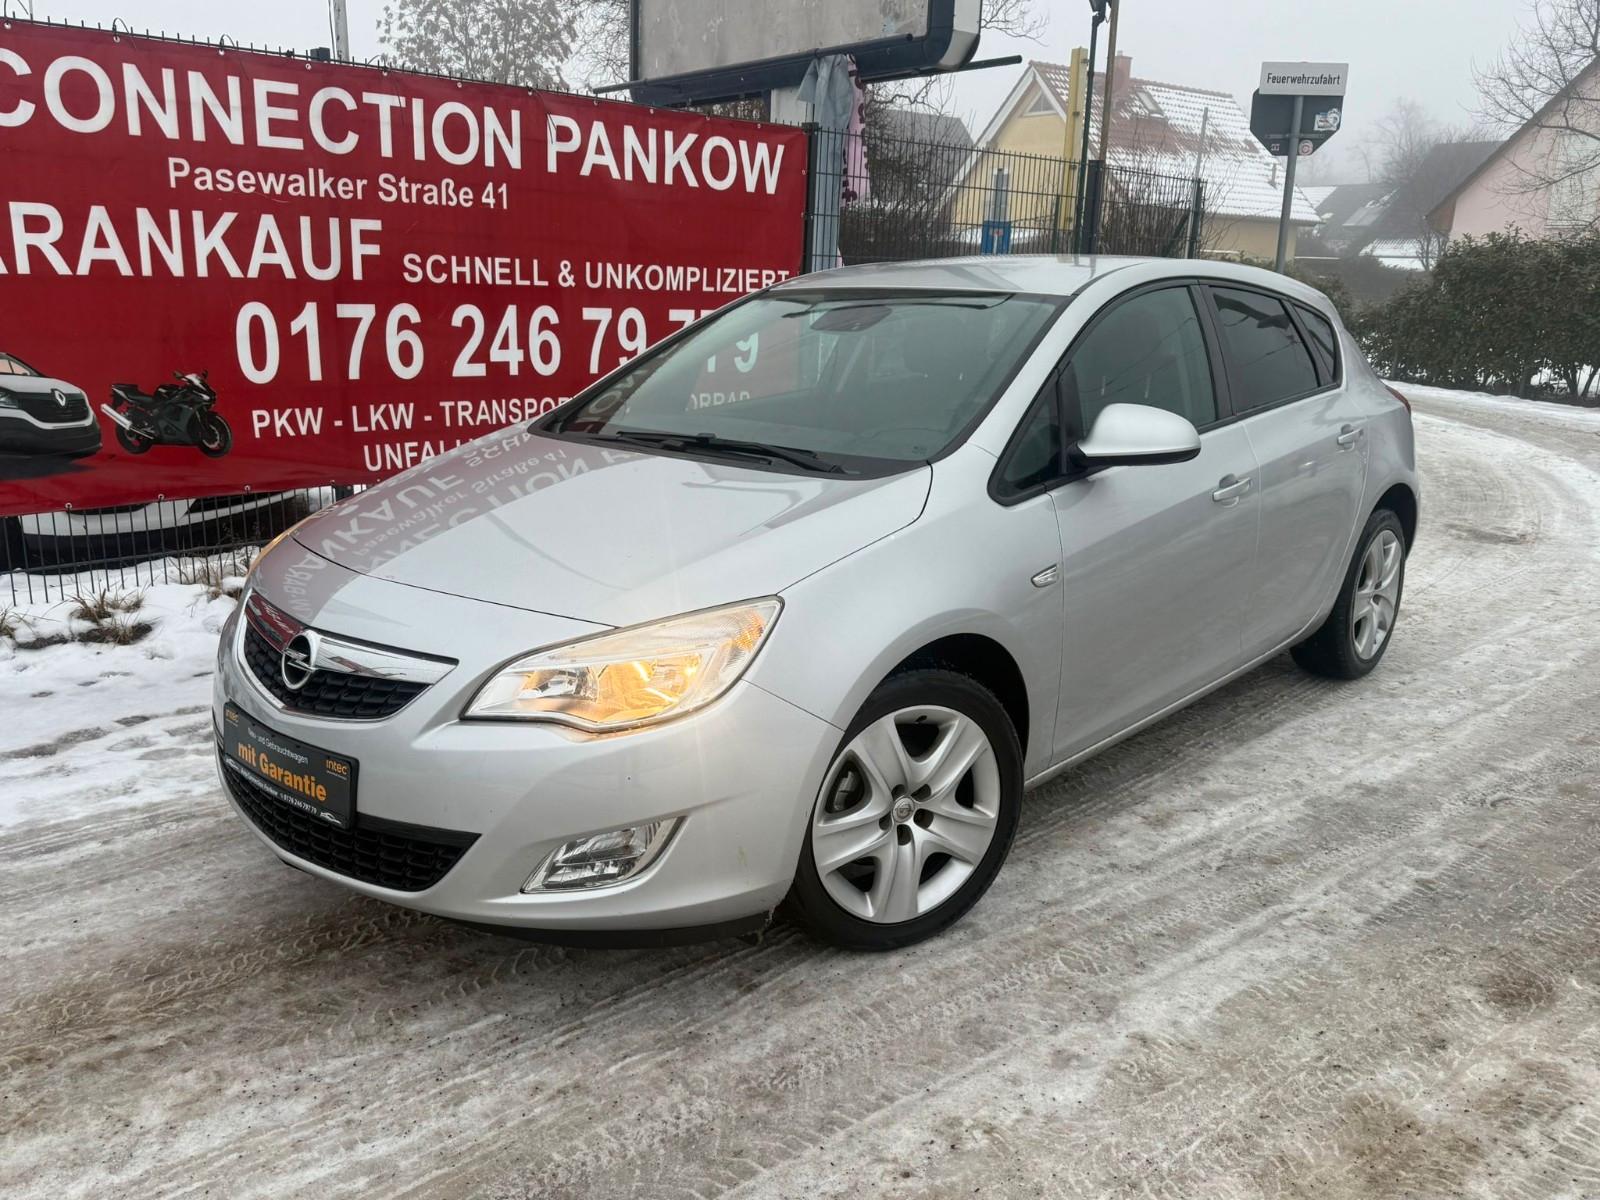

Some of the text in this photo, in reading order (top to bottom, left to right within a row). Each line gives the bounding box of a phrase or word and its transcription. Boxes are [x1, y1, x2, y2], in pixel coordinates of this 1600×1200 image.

[1266, 73, 1340, 85] Feuerwehrzufahrt
[547, 114, 785, 195] PANKOW
[168, 157, 508, 210] Pasewalker Straße 41
[0, 201, 790, 293] RANKAUF SCHNELL & UNKOMPLIZIERT
[236, 301, 424, 385] 0176
[451, 304, 562, 377] 246
[582, 307, 648, 374] 79
[252, 407, 323, 438] PKW
[352, 403, 414, 433] LKW
[238, 742, 257, 767] mit
[259, 752, 327, 801] Garantie
[326, 758, 348, 776] intec
